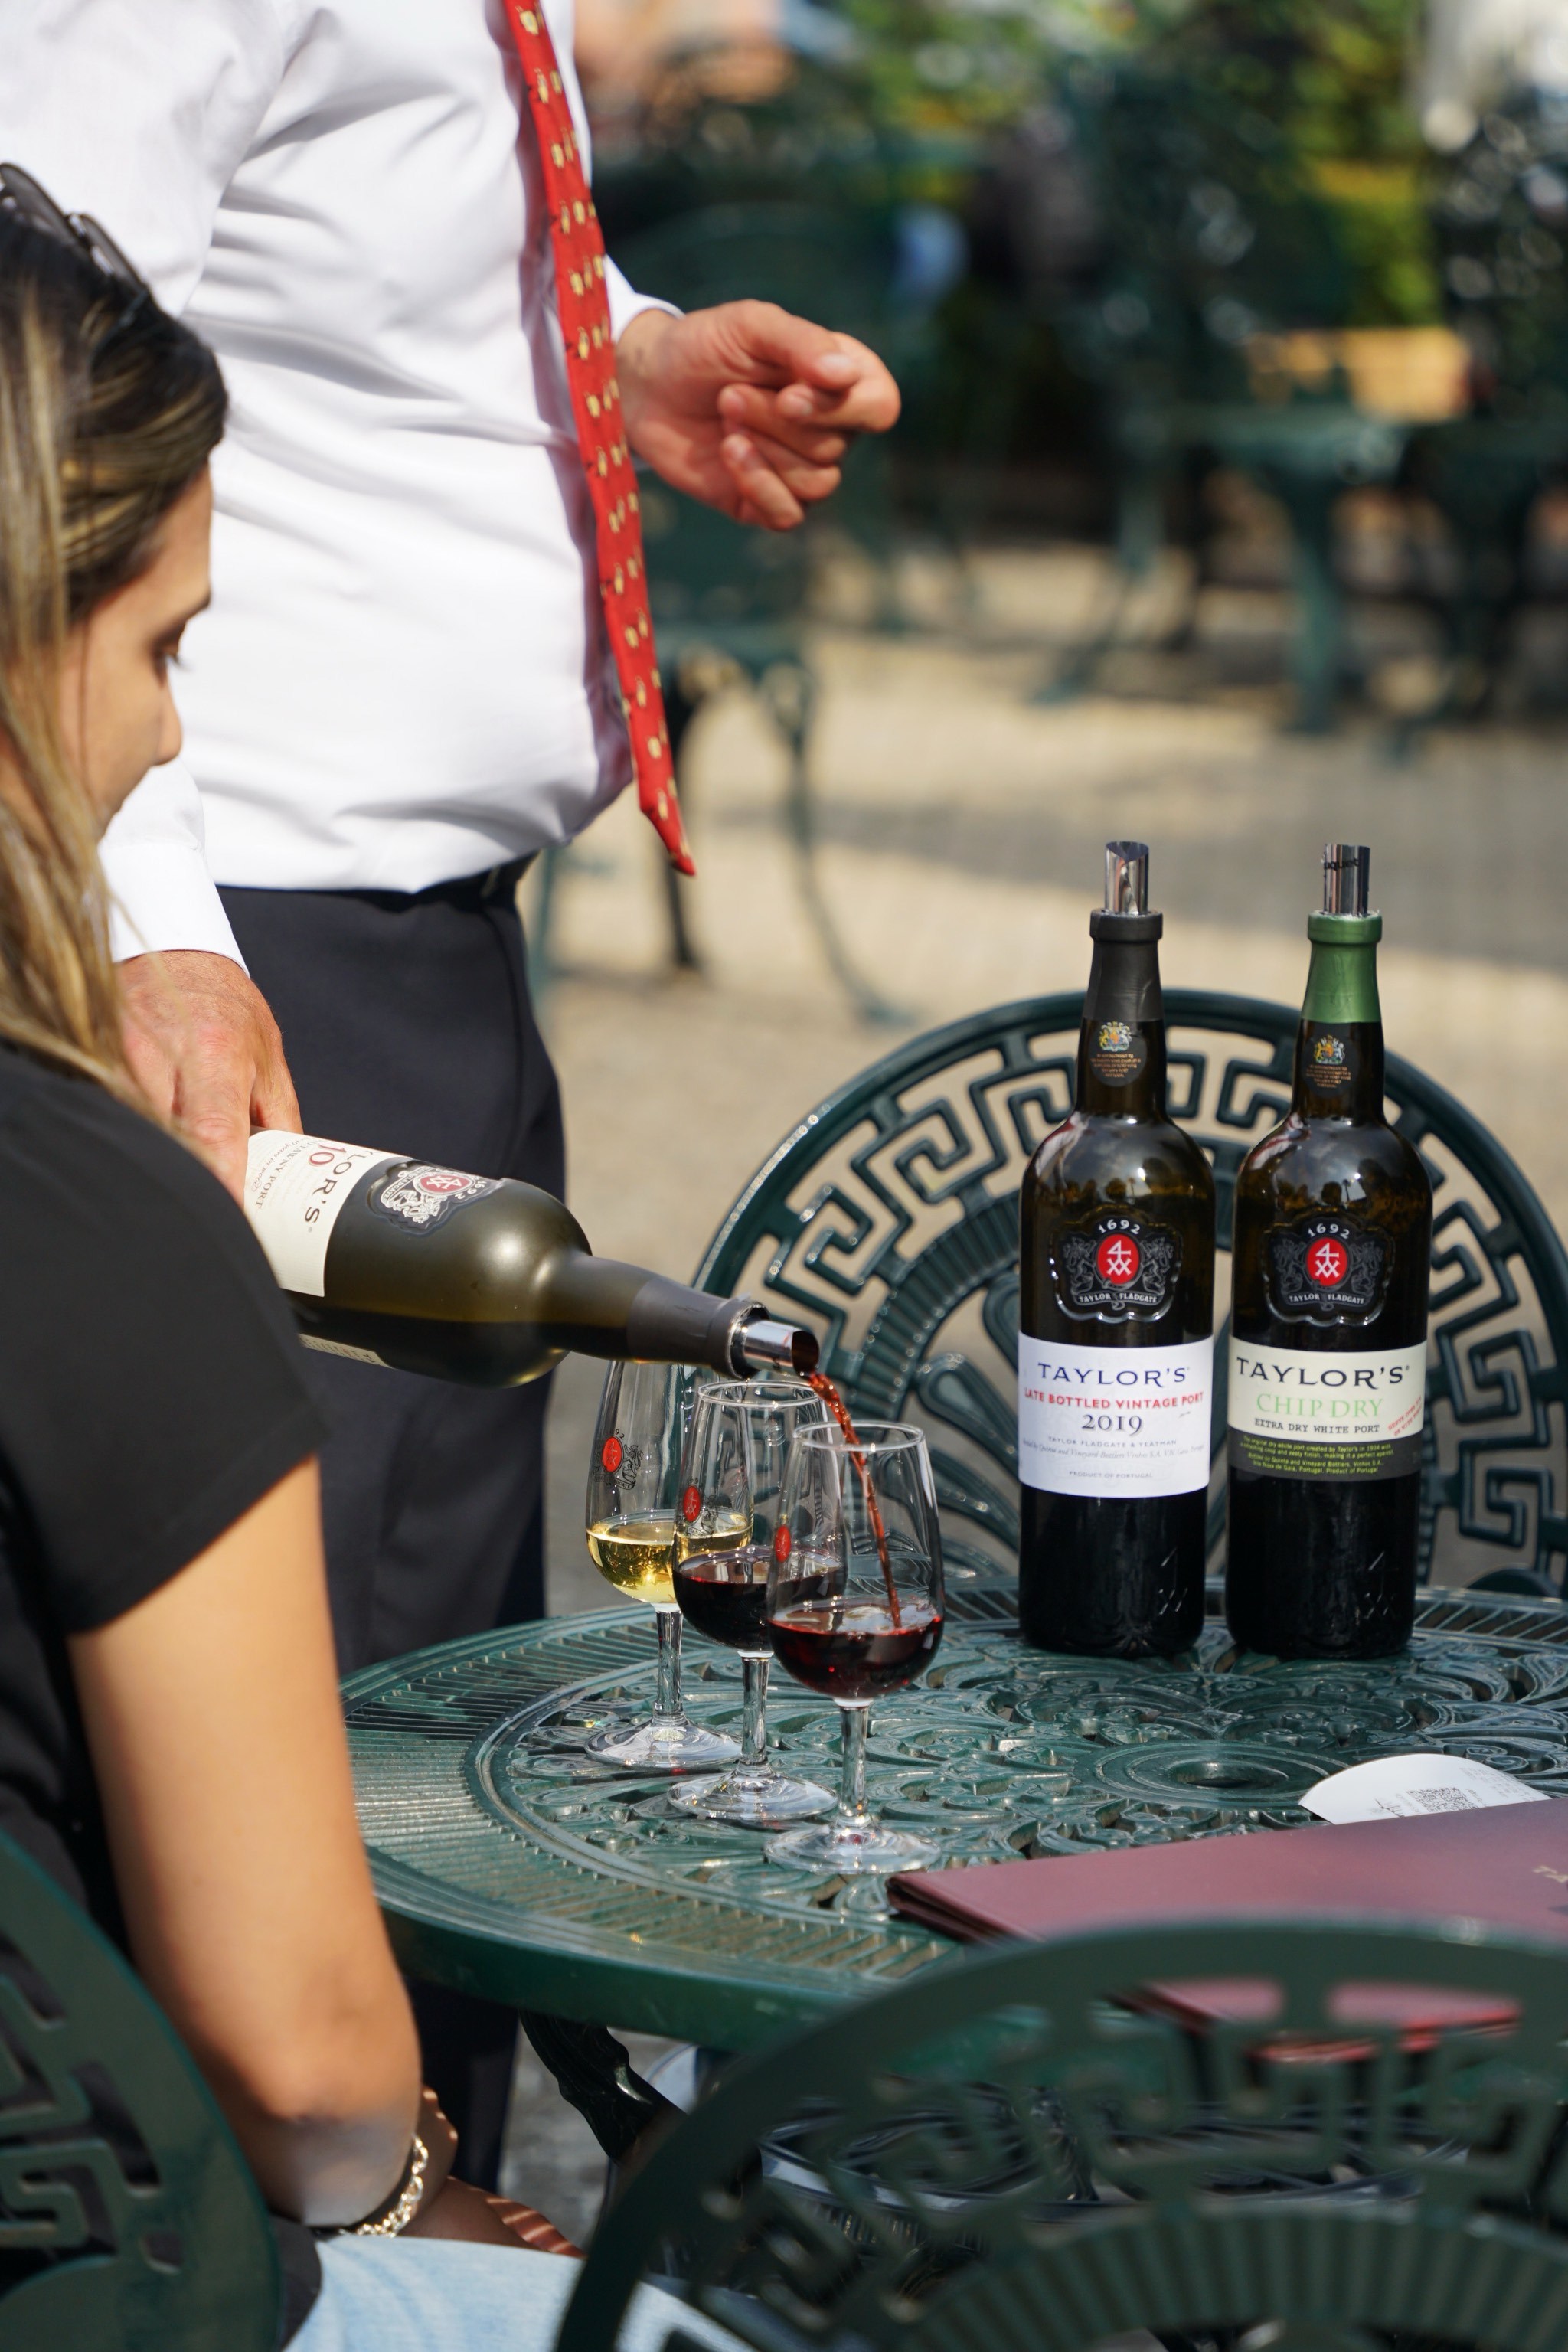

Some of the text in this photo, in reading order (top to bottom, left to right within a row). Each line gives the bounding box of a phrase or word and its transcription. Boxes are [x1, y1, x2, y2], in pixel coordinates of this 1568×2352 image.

[309, 1145, 347, 1166] 10
[255, 1174, 278, 1210] PORT
[1099, 1219, 1141, 1235] 1692
[1308, 1223, 1351, 1240] 1692
[1080, 1293, 1157, 1303] TAYLOR FLADGATE
[1289, 1294, 1364, 1304] TAYLOR FLADGATE
[1037, 1362, 1187, 1388] TAYLOR'S
[1236, 1357, 1403, 1390] TAYLOR'S
[1024, 1387, 1204, 1409] LATE BOTTLED VINTAGE PORT
[1256, 1393, 1383, 1418] CHIP DRY
[1081, 1413, 1143, 1436] 2019
[1255, 1418, 1380, 1434] EXTRA DRY WHITE PORT
